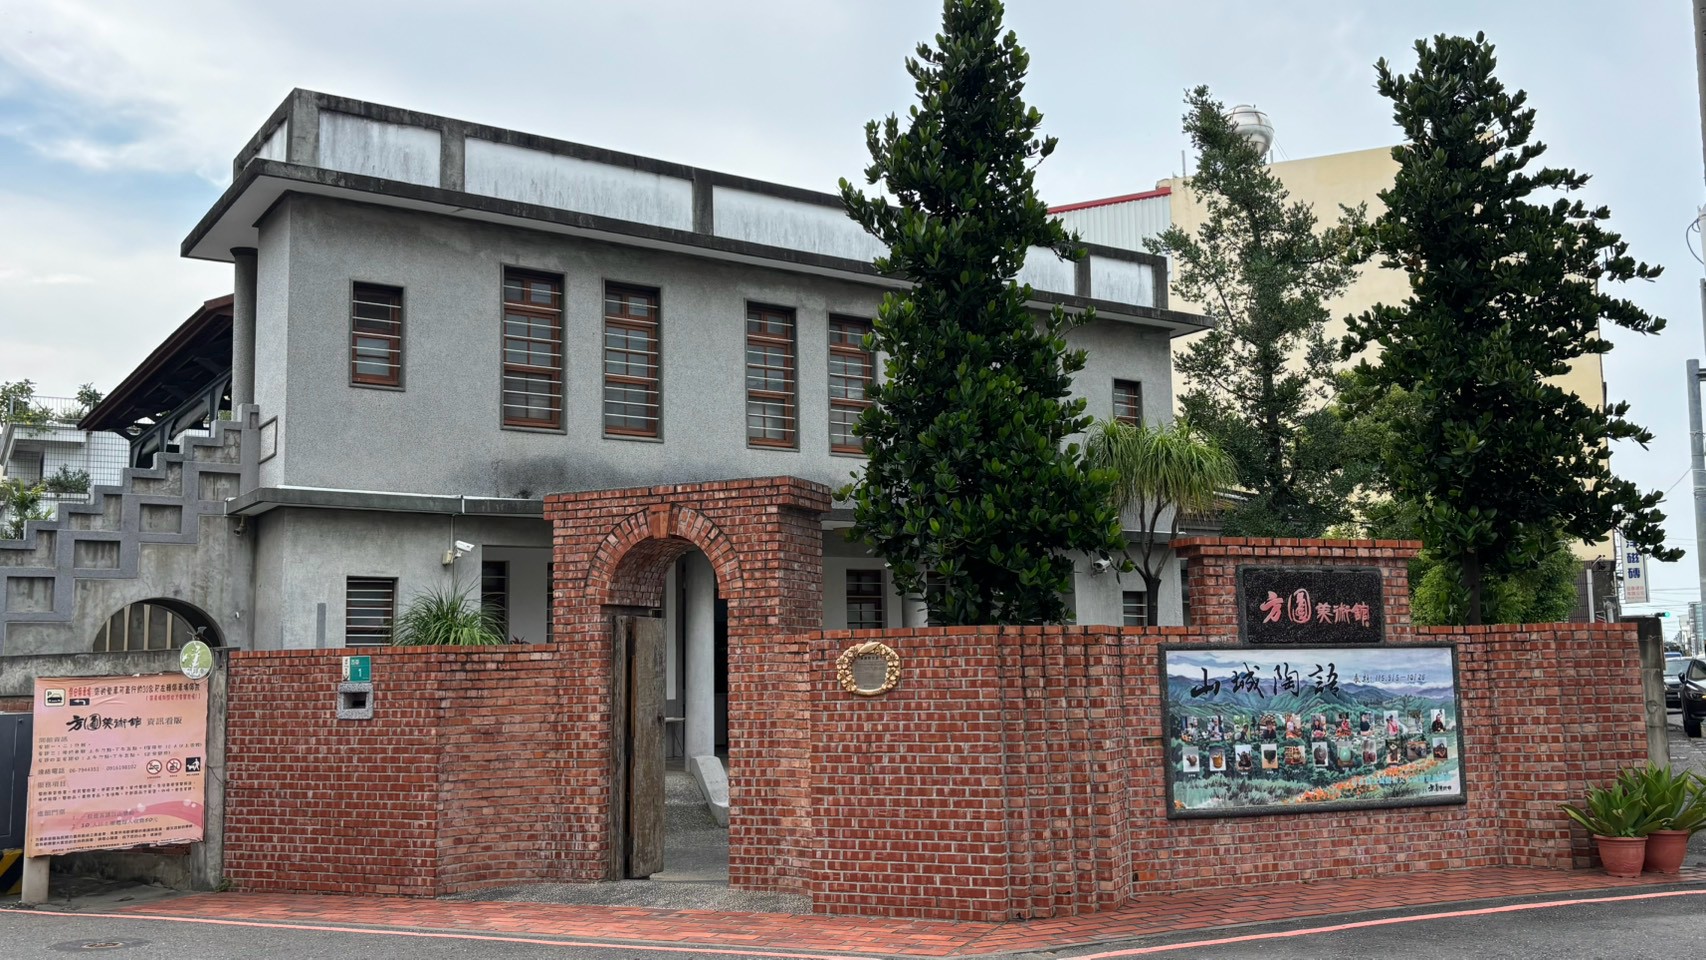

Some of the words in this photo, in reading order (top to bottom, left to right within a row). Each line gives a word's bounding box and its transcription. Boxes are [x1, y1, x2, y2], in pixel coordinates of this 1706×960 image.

[1260, 588, 1370, 627] 方圓美術館
[1190, 662, 1340, 699] 山城陶語
[66, 713, 142, 732] 方圓美術館
